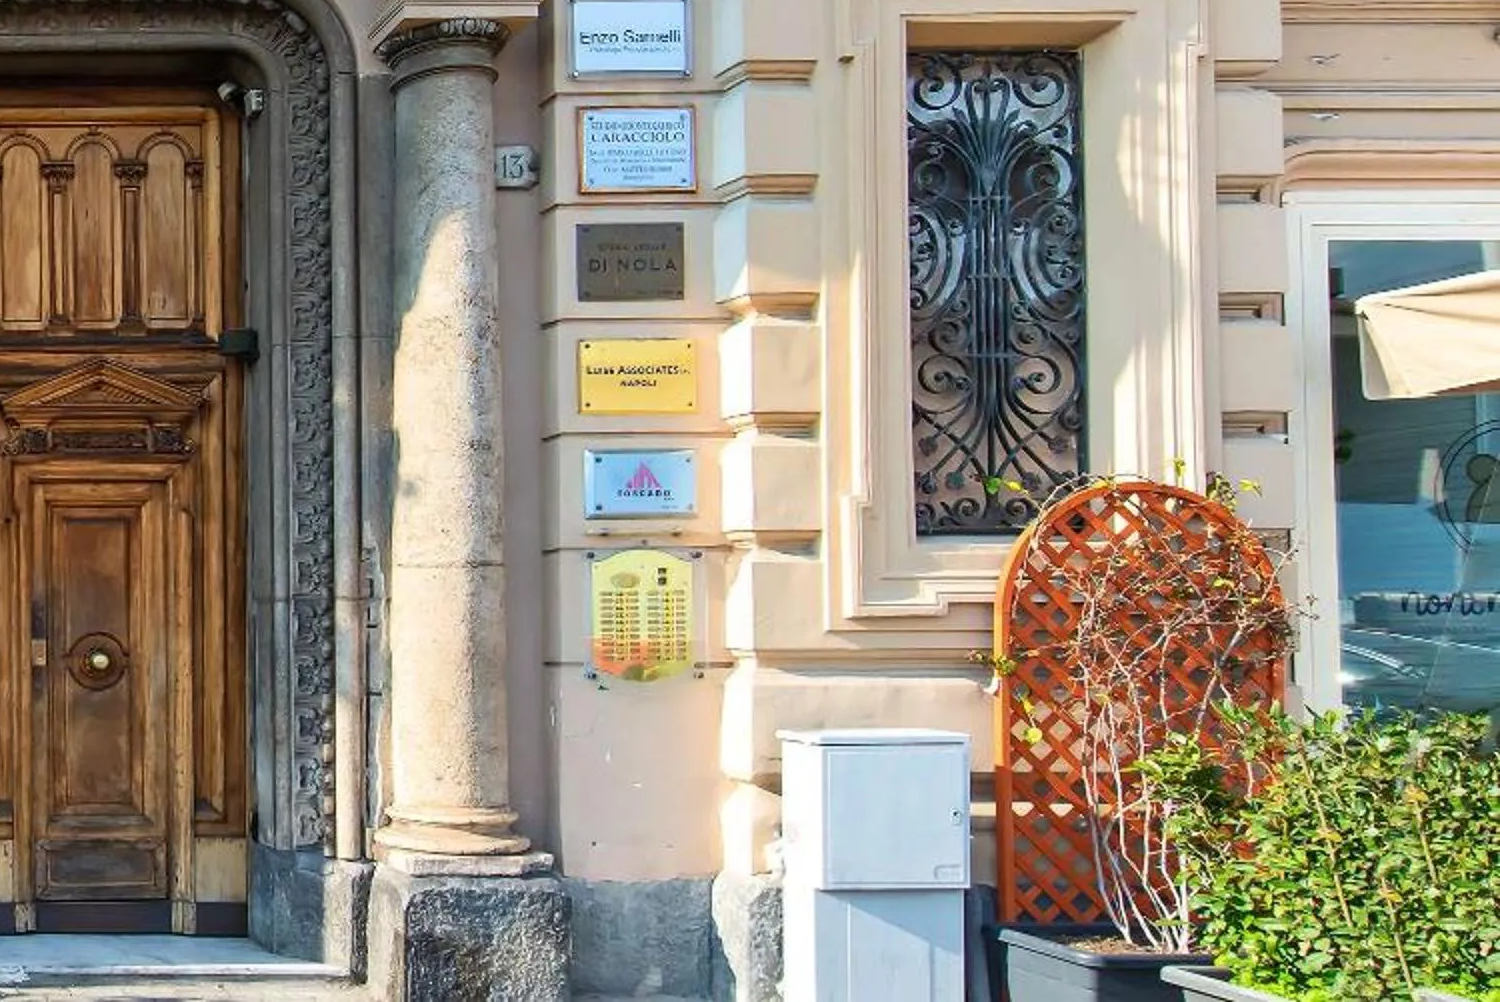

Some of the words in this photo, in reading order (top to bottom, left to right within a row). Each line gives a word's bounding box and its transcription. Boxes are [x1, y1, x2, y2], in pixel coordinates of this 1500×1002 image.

[579, 31, 619, 45] Enzo
[501, 153, 524, 179] 13
[617, 259, 677, 273] NOLA
[620, 379, 657, 387] NAPOLI
